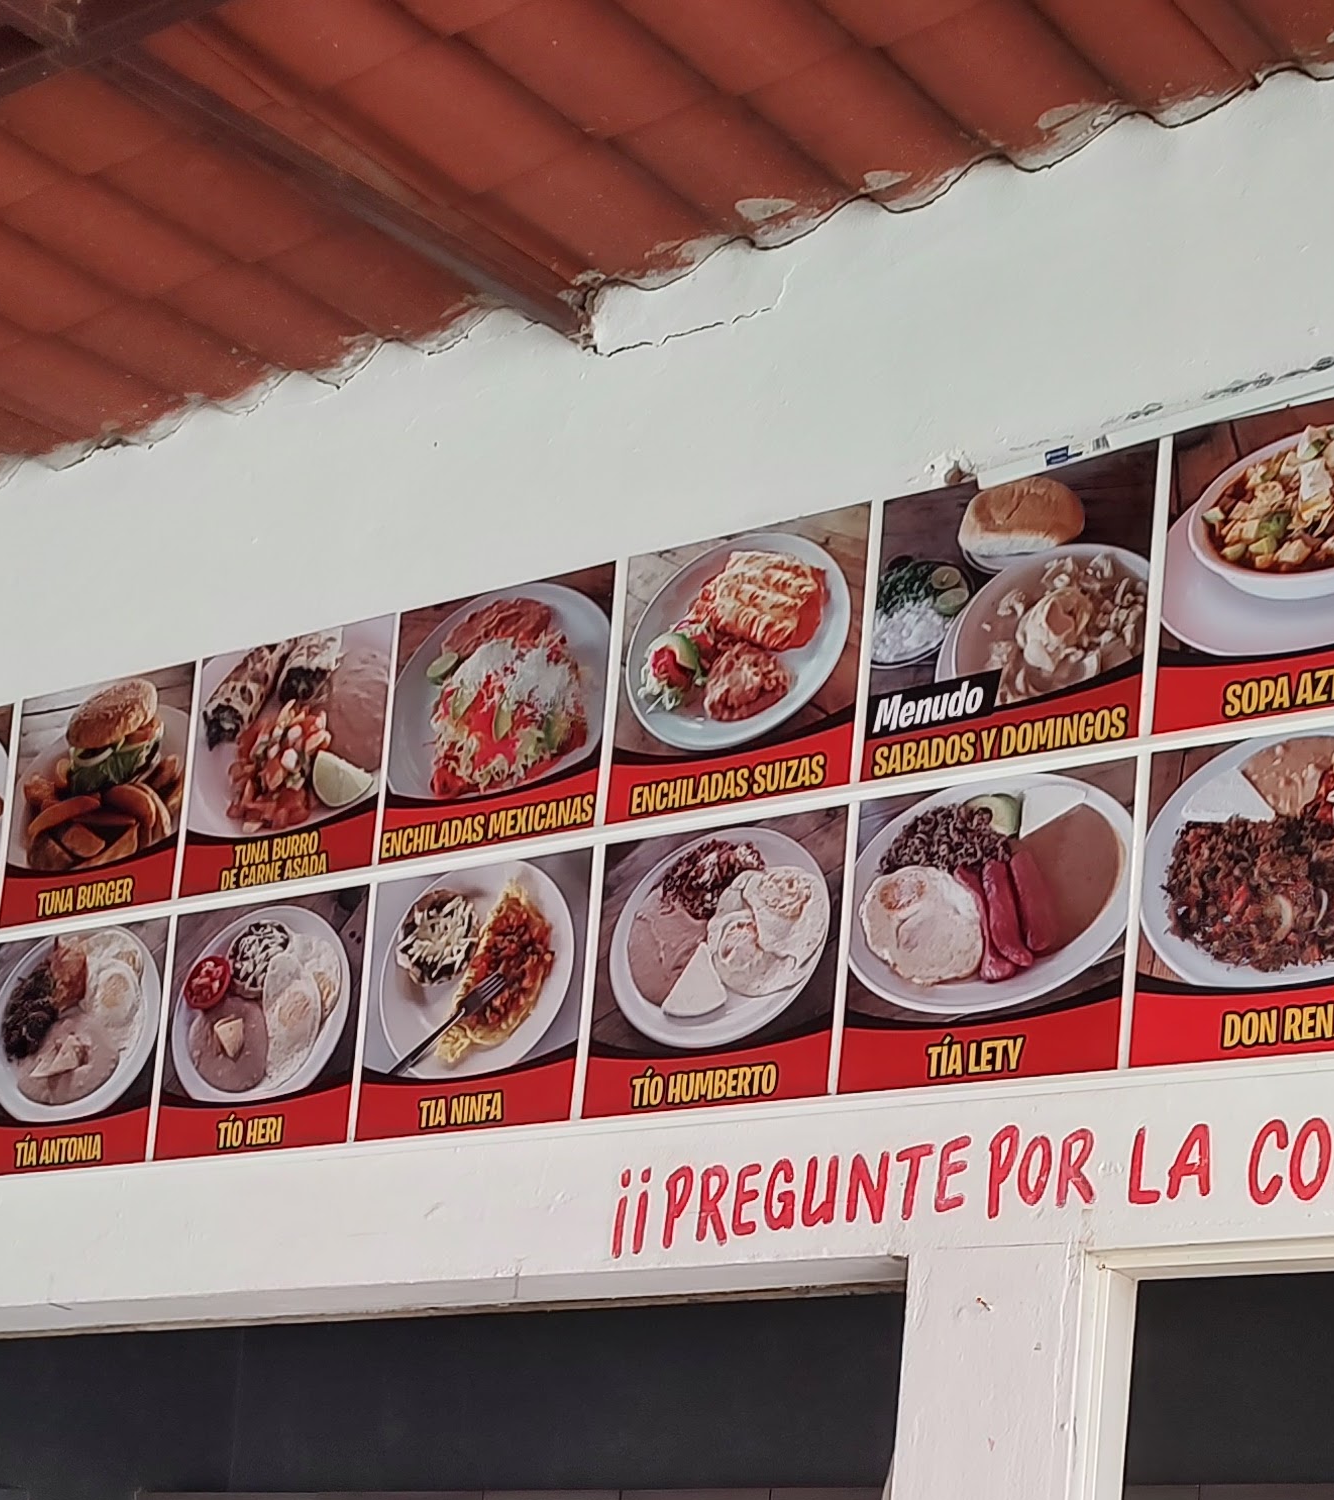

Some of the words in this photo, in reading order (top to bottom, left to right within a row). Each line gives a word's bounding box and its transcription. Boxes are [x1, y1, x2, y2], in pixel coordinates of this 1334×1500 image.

[871, 680, 984, 734] Menudo
[1223, 679, 1292, 718] SOPA
[872, 732, 977, 778] SABADOS
[979, 727, 999, 761] Y
[999, 706, 1128, 757] DOMINGOS
[629, 767, 752, 816] ENCHILADAS
[753, 754, 826, 792] SUIZAS
[379, 814, 486, 860] ENCHILADAS
[486, 793, 595, 840] MEXICANAS
[233, 838, 271, 869] TUNA
[271, 829, 320, 861] BURRO
[219, 867, 239, 892] DE
[238, 857, 283, 889] CARNE
[282, 851, 328, 882] ASADA
[37, 887, 74, 917] TUNA
[75, 876, 134, 911] BURGER
[1221, 1009, 1278, 1049] DON
[927, 1034, 966, 1078] TÍA
[967, 1036, 1024, 1073] LETY
[631, 1068, 666, 1108] TÍO
[667, 1062, 778, 1103] HUMBERTO
[419, 1098, 447, 1128] TIA
[449, 1090, 503, 1126] NINFA
[15, 1133, 39, 1168] TÍA
[39, 1133, 103, 1165] ANTONIA
[217, 1113, 244, 1149] TÍO
[245, 1115, 284, 1146] HERI
[987, 1123, 1096, 1220] POR
[1126, 1123, 1211, 1205] LA
